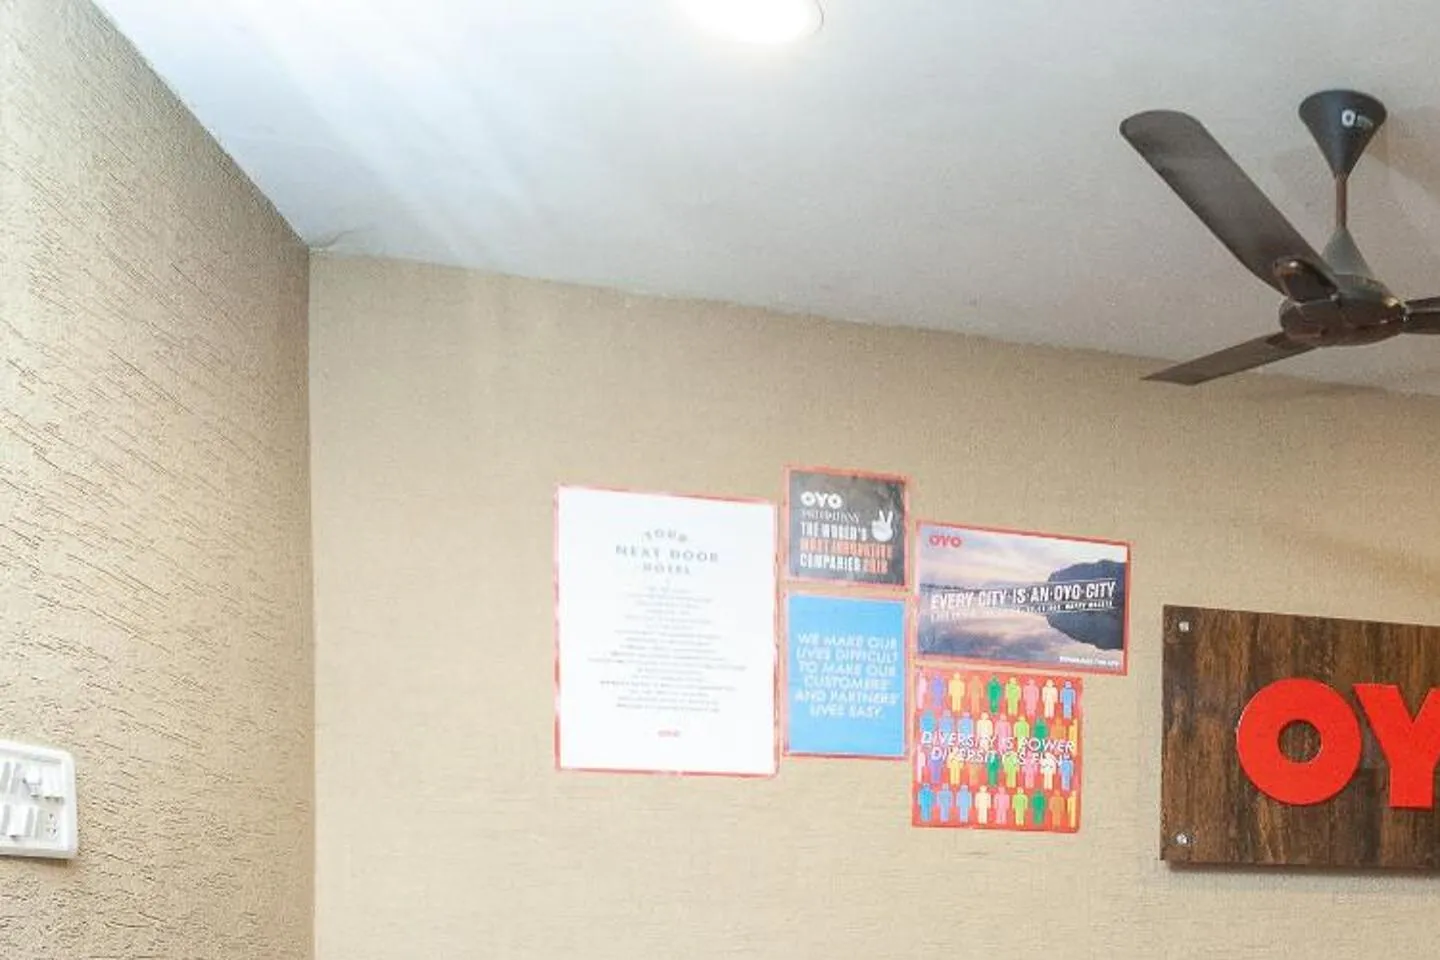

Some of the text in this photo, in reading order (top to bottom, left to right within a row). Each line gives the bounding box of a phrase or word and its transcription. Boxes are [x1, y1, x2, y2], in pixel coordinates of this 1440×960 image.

[800, 491, 842, 509] OYO
[800, 520, 819, 538] THE
[928, 534, 963, 548] OYO
[615, 544, 719, 563] NEXT DOOR
[800, 553, 861, 572] COMPANIES
[930, 591, 975, 613] EVERY
[979, 589, 1006, 607] CITY
[1012, 588, 1026, 604] IS
[1030, 586, 1049, 602] AN
[1053, 584, 1081, 601] OYO
[1086, 581, 1117, 599] CITY
[798, 632, 897, 649] WE MAKE OUR
[799, 660, 896, 678] TO MAKE OUR
[922, 731, 1075, 754] DIVERSITY IS POWER
[932, 746, 1009, 766] DIVERSITY
